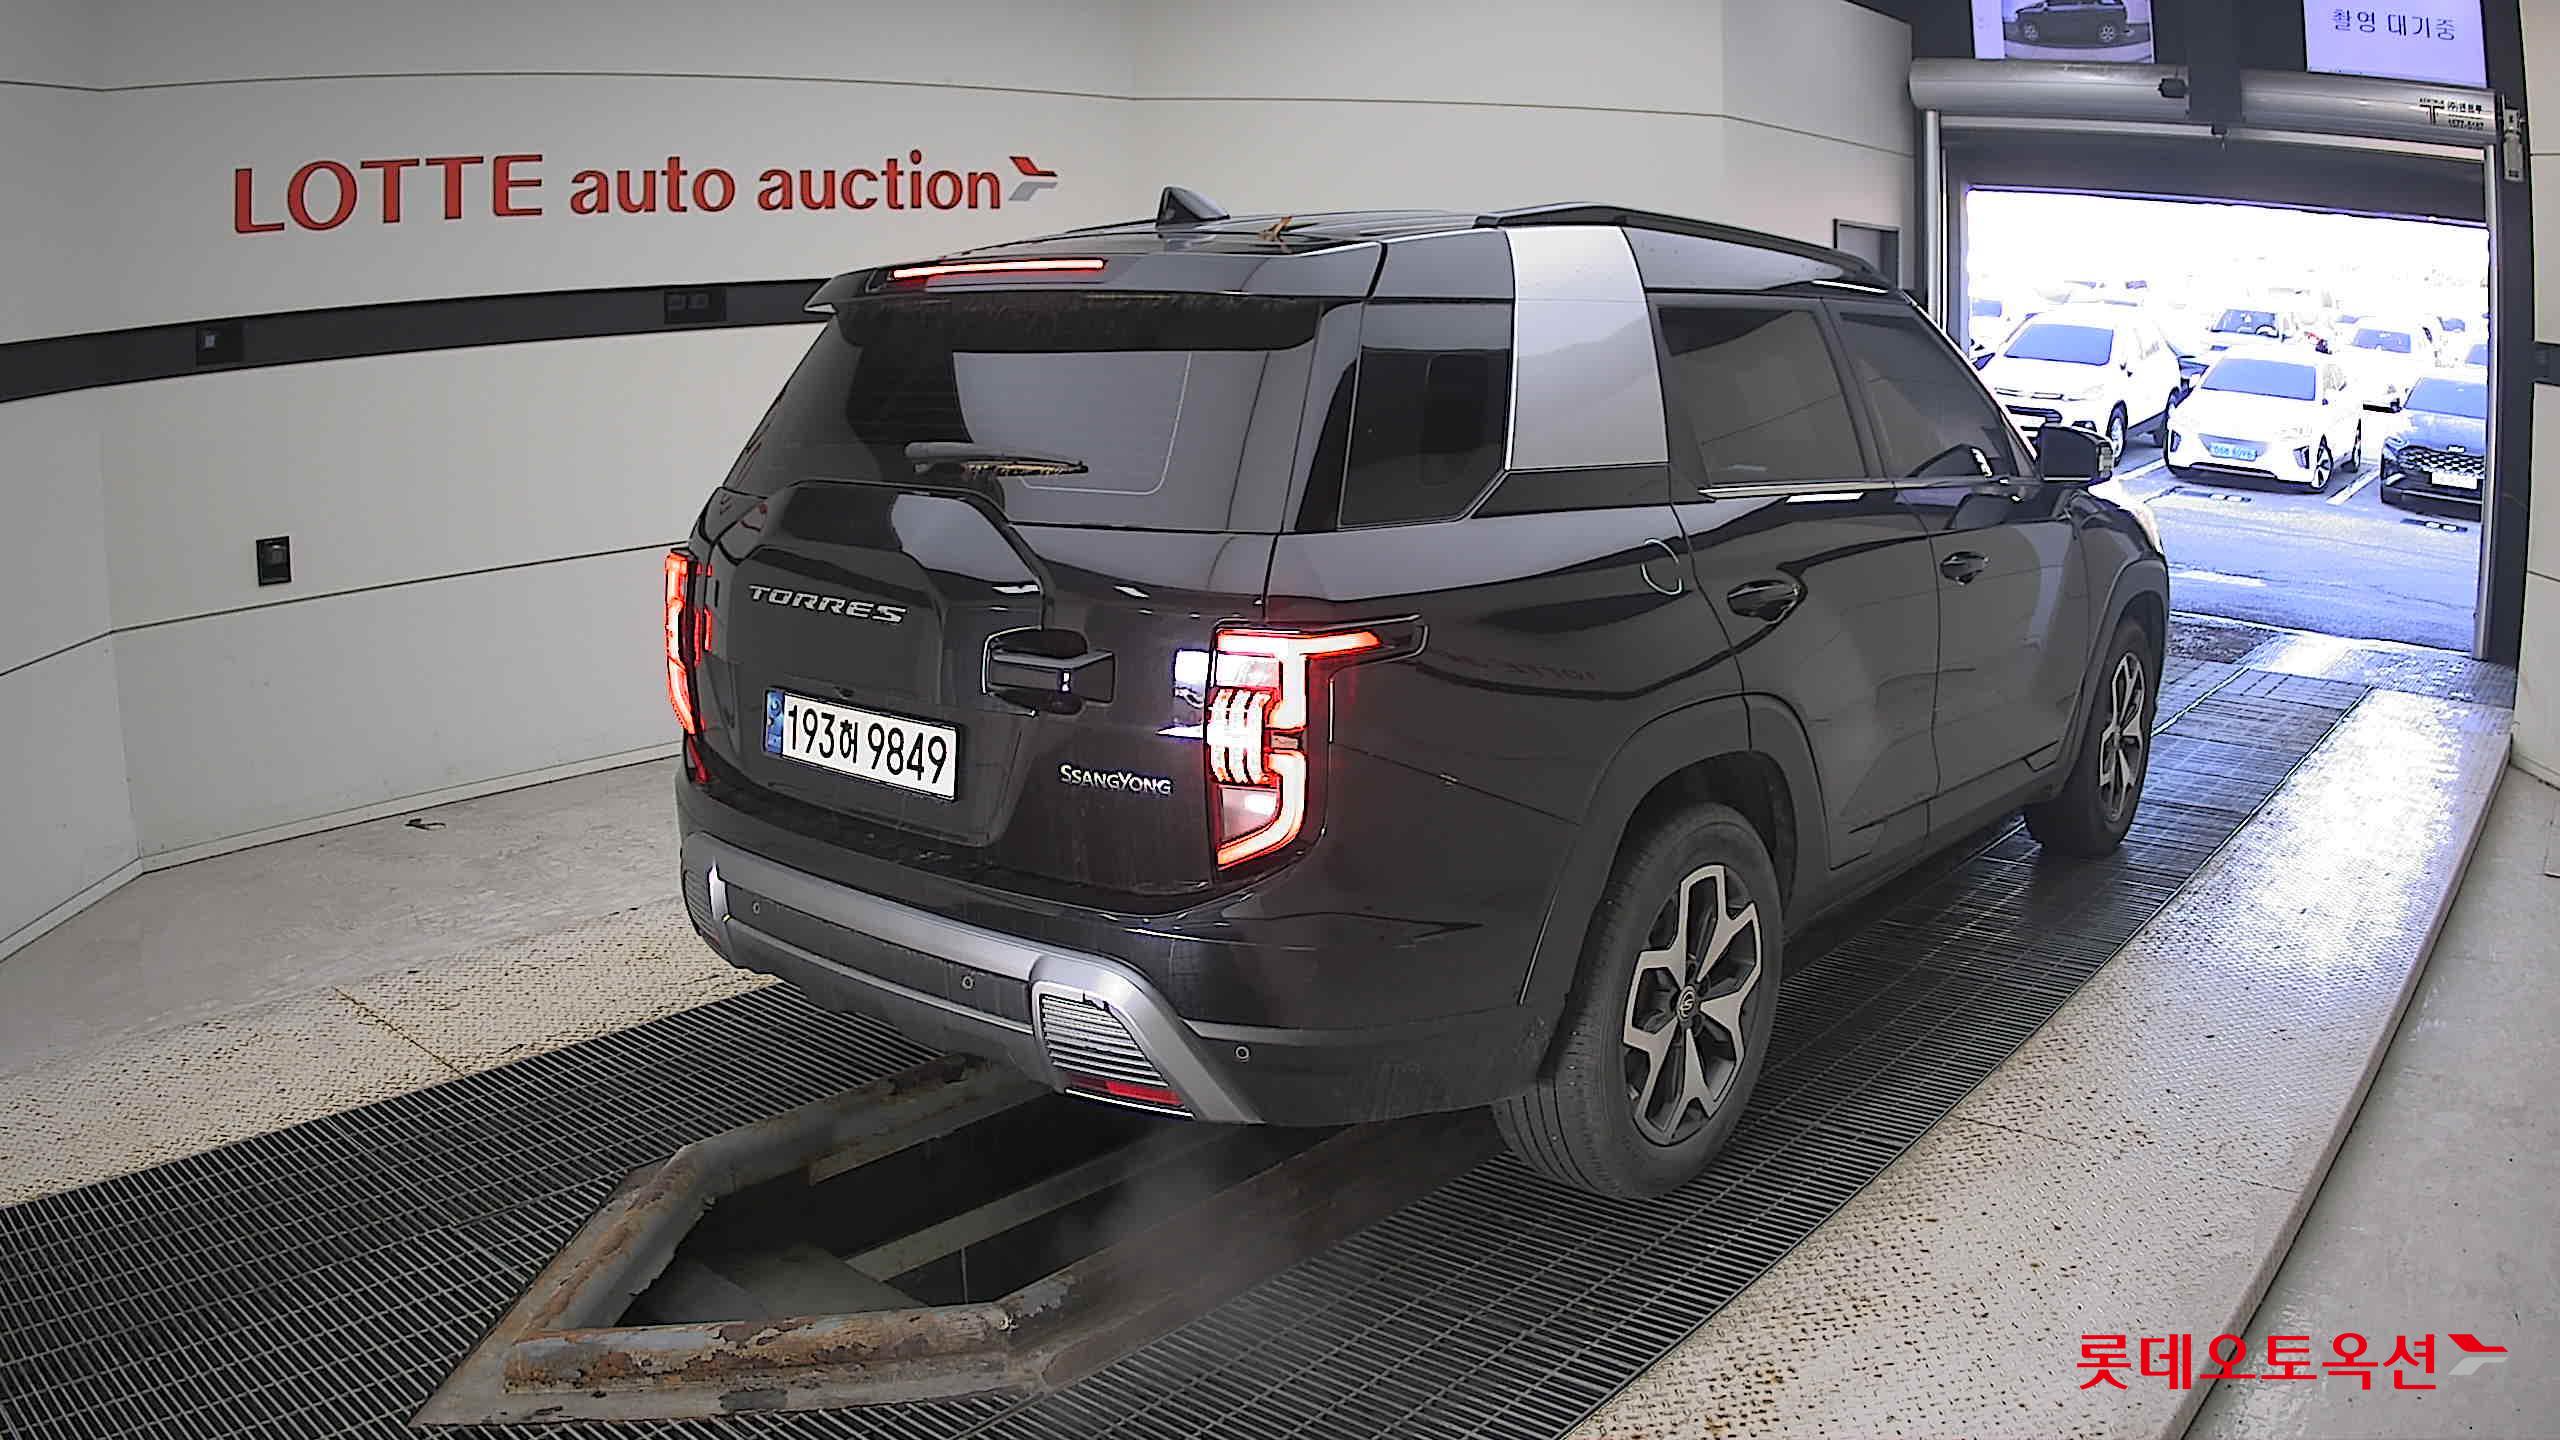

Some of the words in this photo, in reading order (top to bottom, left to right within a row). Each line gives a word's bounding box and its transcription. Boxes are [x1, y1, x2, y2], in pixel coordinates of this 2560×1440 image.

[2387, 14, 2455, 41] 대기중
[234, 153, 543, 234] LOTTE
[569, 156, 736, 214] auto
[756, 149, 1001, 210] auction
[749, 584, 907, 623] TORRES
[788, 704, 859, 764] 193허
[867, 722, 948, 785] 9849
